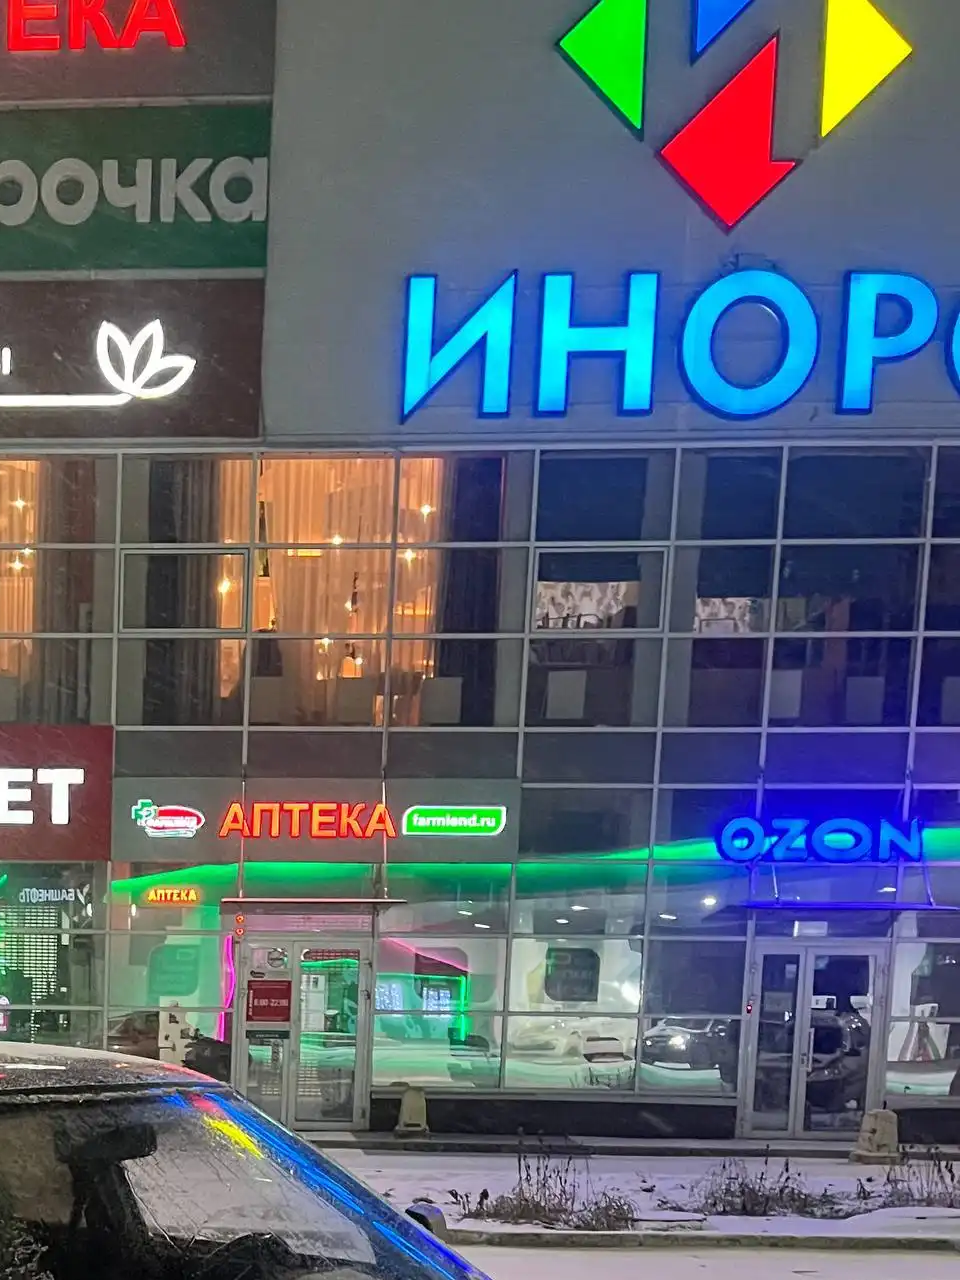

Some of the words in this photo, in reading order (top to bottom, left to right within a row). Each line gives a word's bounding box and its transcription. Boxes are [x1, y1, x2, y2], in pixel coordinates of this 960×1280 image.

[400, 268, 960, 424] ИНОР
[218, 802, 397, 839] АПТЕКА
[719, 816, 924, 863] OZON
[147, 888, 197, 901] АПТЕКА
